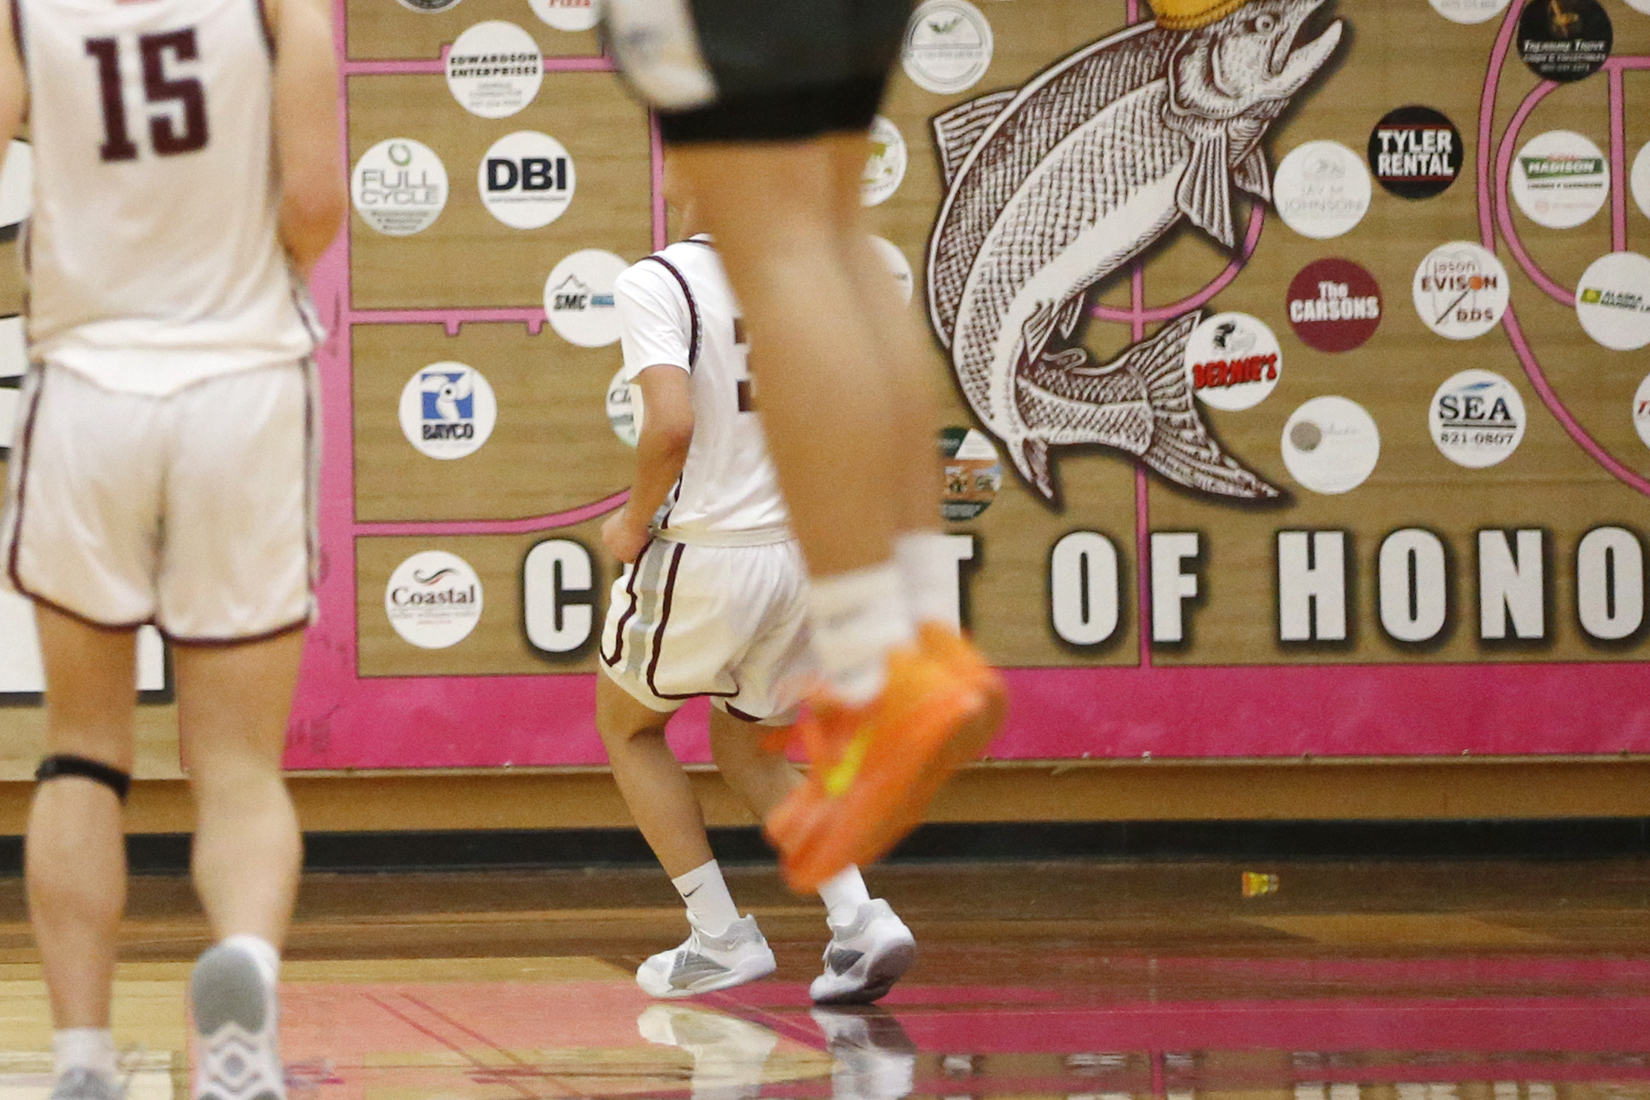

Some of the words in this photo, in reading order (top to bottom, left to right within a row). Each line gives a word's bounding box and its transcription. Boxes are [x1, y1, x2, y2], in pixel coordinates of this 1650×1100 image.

[85, 26, 210, 163] 15
[1377, 129, 1453, 152] TYLER
[487, 158, 567, 191] DBI
[1377, 152, 1455, 176] RENTAL
[360, 169, 437, 189] FULL
[360, 187, 439, 205] CYCLE
[1434, 261, 1476, 274] jason
[1318, 281, 1348, 298] The
[1290, 298, 1380, 323] CARSONS
[1457, 308, 1493, 322] DDS
[1439, 396, 1512, 421] SEA
[392, 586, 475, 606] Coastal
[1048, 530, 1199, 646] OF
